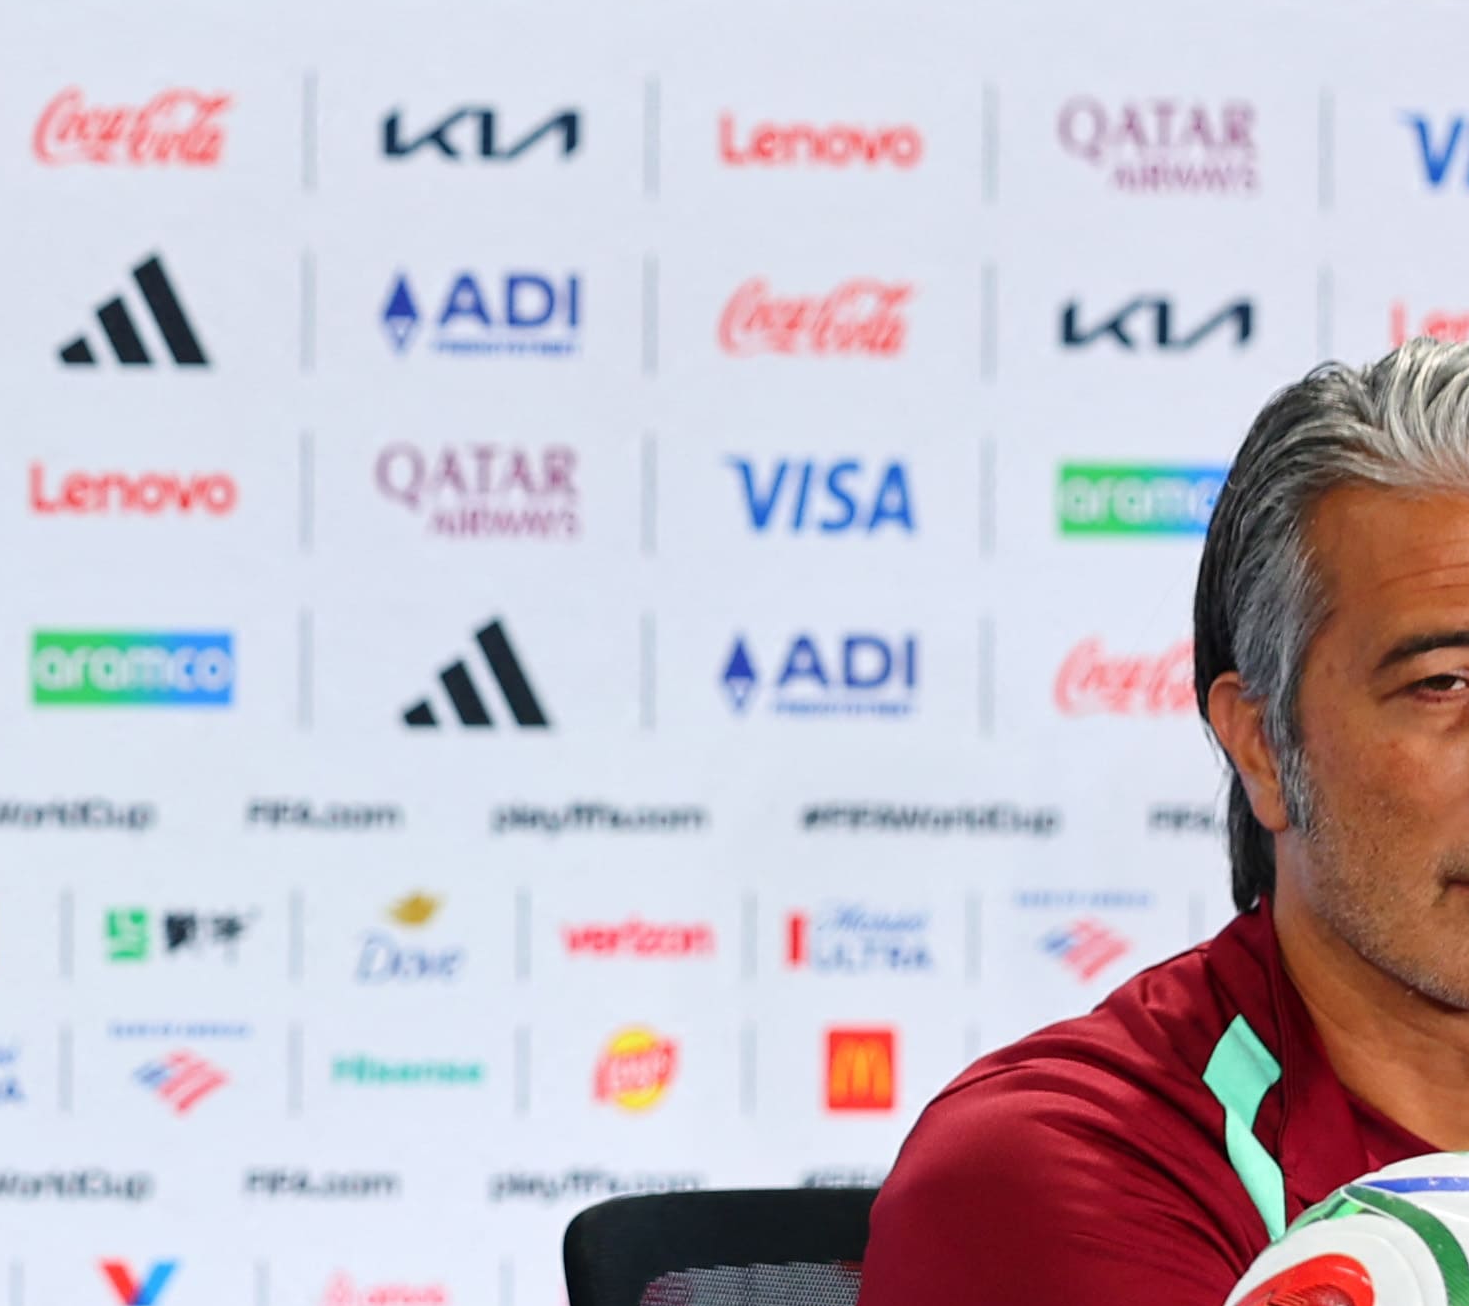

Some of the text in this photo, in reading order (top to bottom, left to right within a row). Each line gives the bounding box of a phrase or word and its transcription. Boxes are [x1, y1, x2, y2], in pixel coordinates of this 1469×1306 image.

[31, 89, 232, 167] Coca-Cola
[719, 116, 923, 169] Lenovo
[1058, 101, 1254, 162] QATAR
[436, 271, 581, 328] ADI
[28, 463, 238, 516] Lenovo
[375, 445, 576, 512] QATAR
[733, 458, 916, 535] VISA
[32, 647, 231, 691] aramco
[775, 633, 918, 689] ADI
